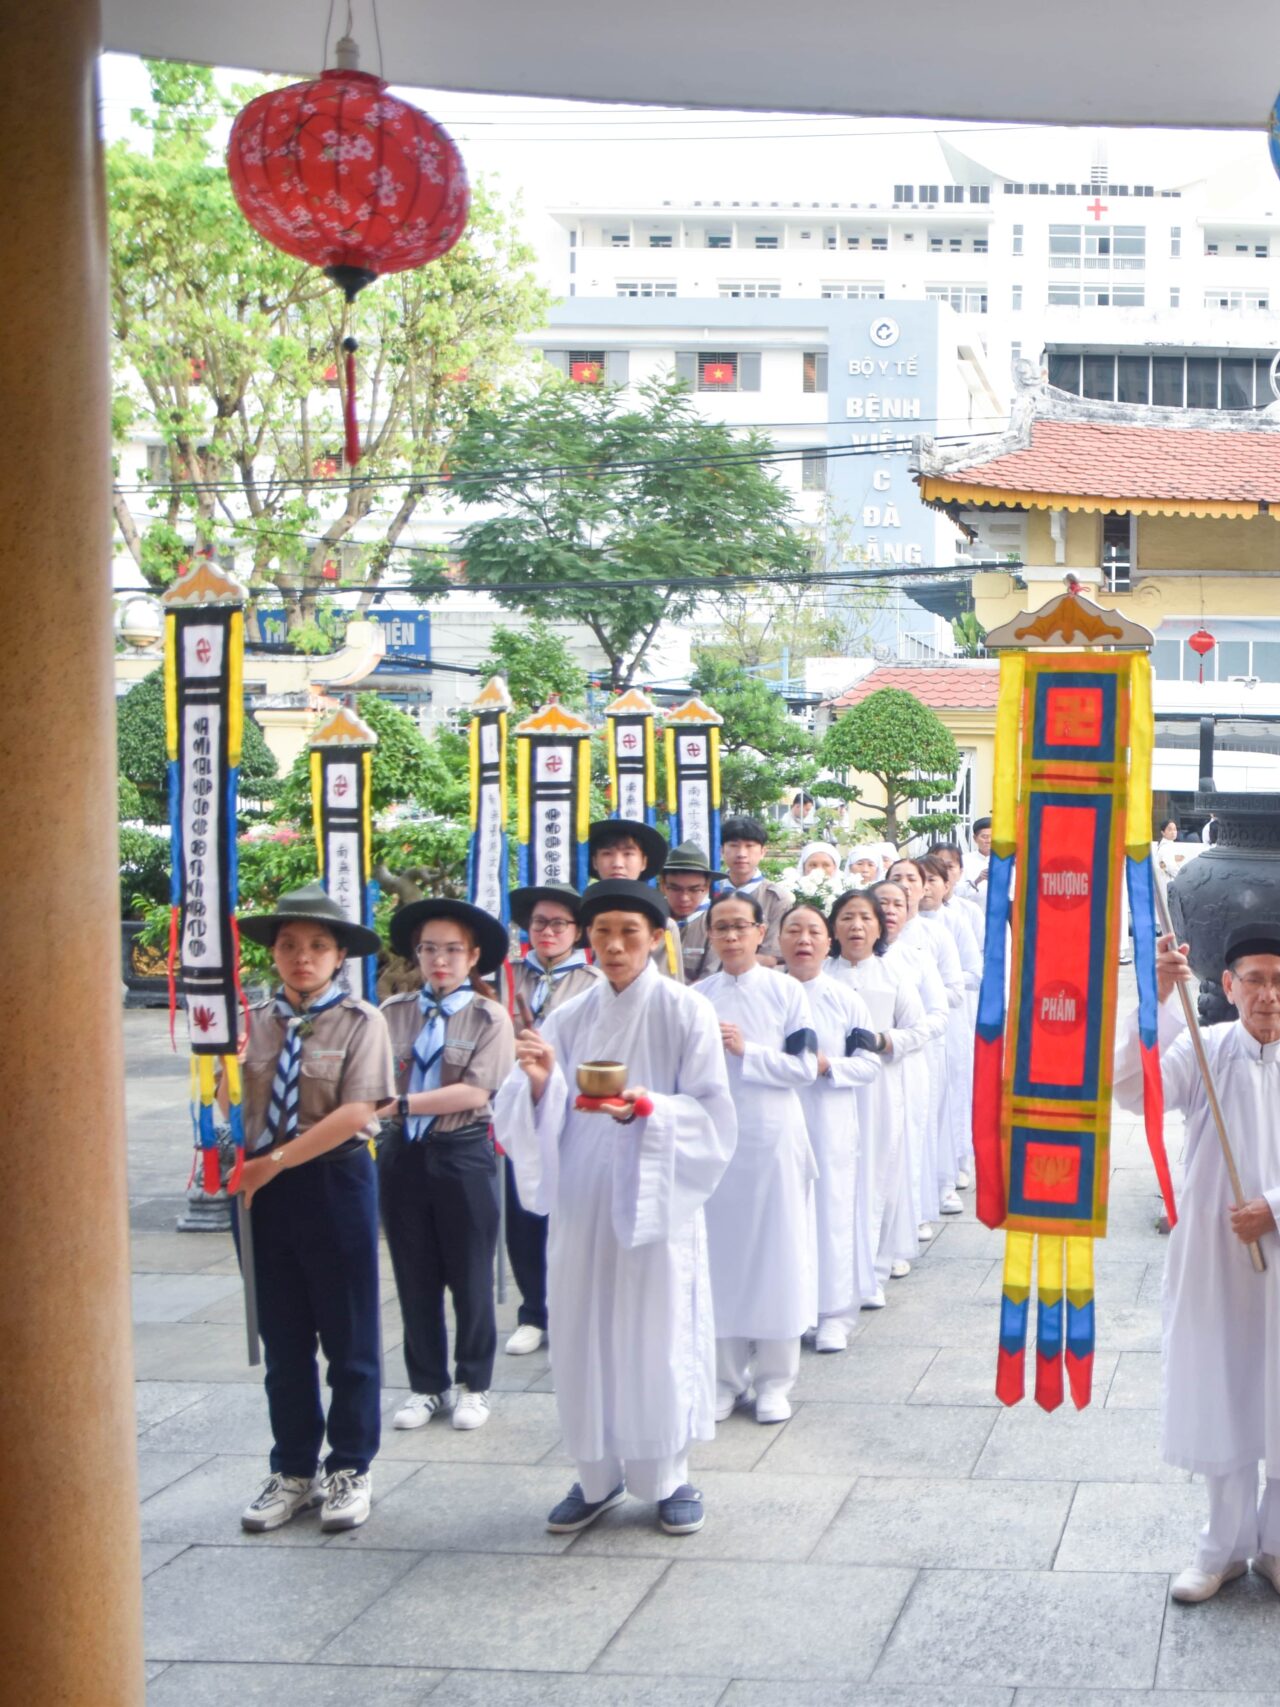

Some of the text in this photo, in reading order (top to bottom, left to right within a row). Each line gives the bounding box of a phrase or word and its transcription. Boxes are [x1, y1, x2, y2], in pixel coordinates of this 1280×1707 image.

[849, 354, 918, 379] BỘ Y TẾ
[846, 393, 920, 422] BỆNH
[872, 469, 890, 492] C
[863, 501, 901, 528] ĐÀ
[1042, 871, 1088, 899] THƯỢNG
[1041, 989, 1076, 1022] PHẨM
